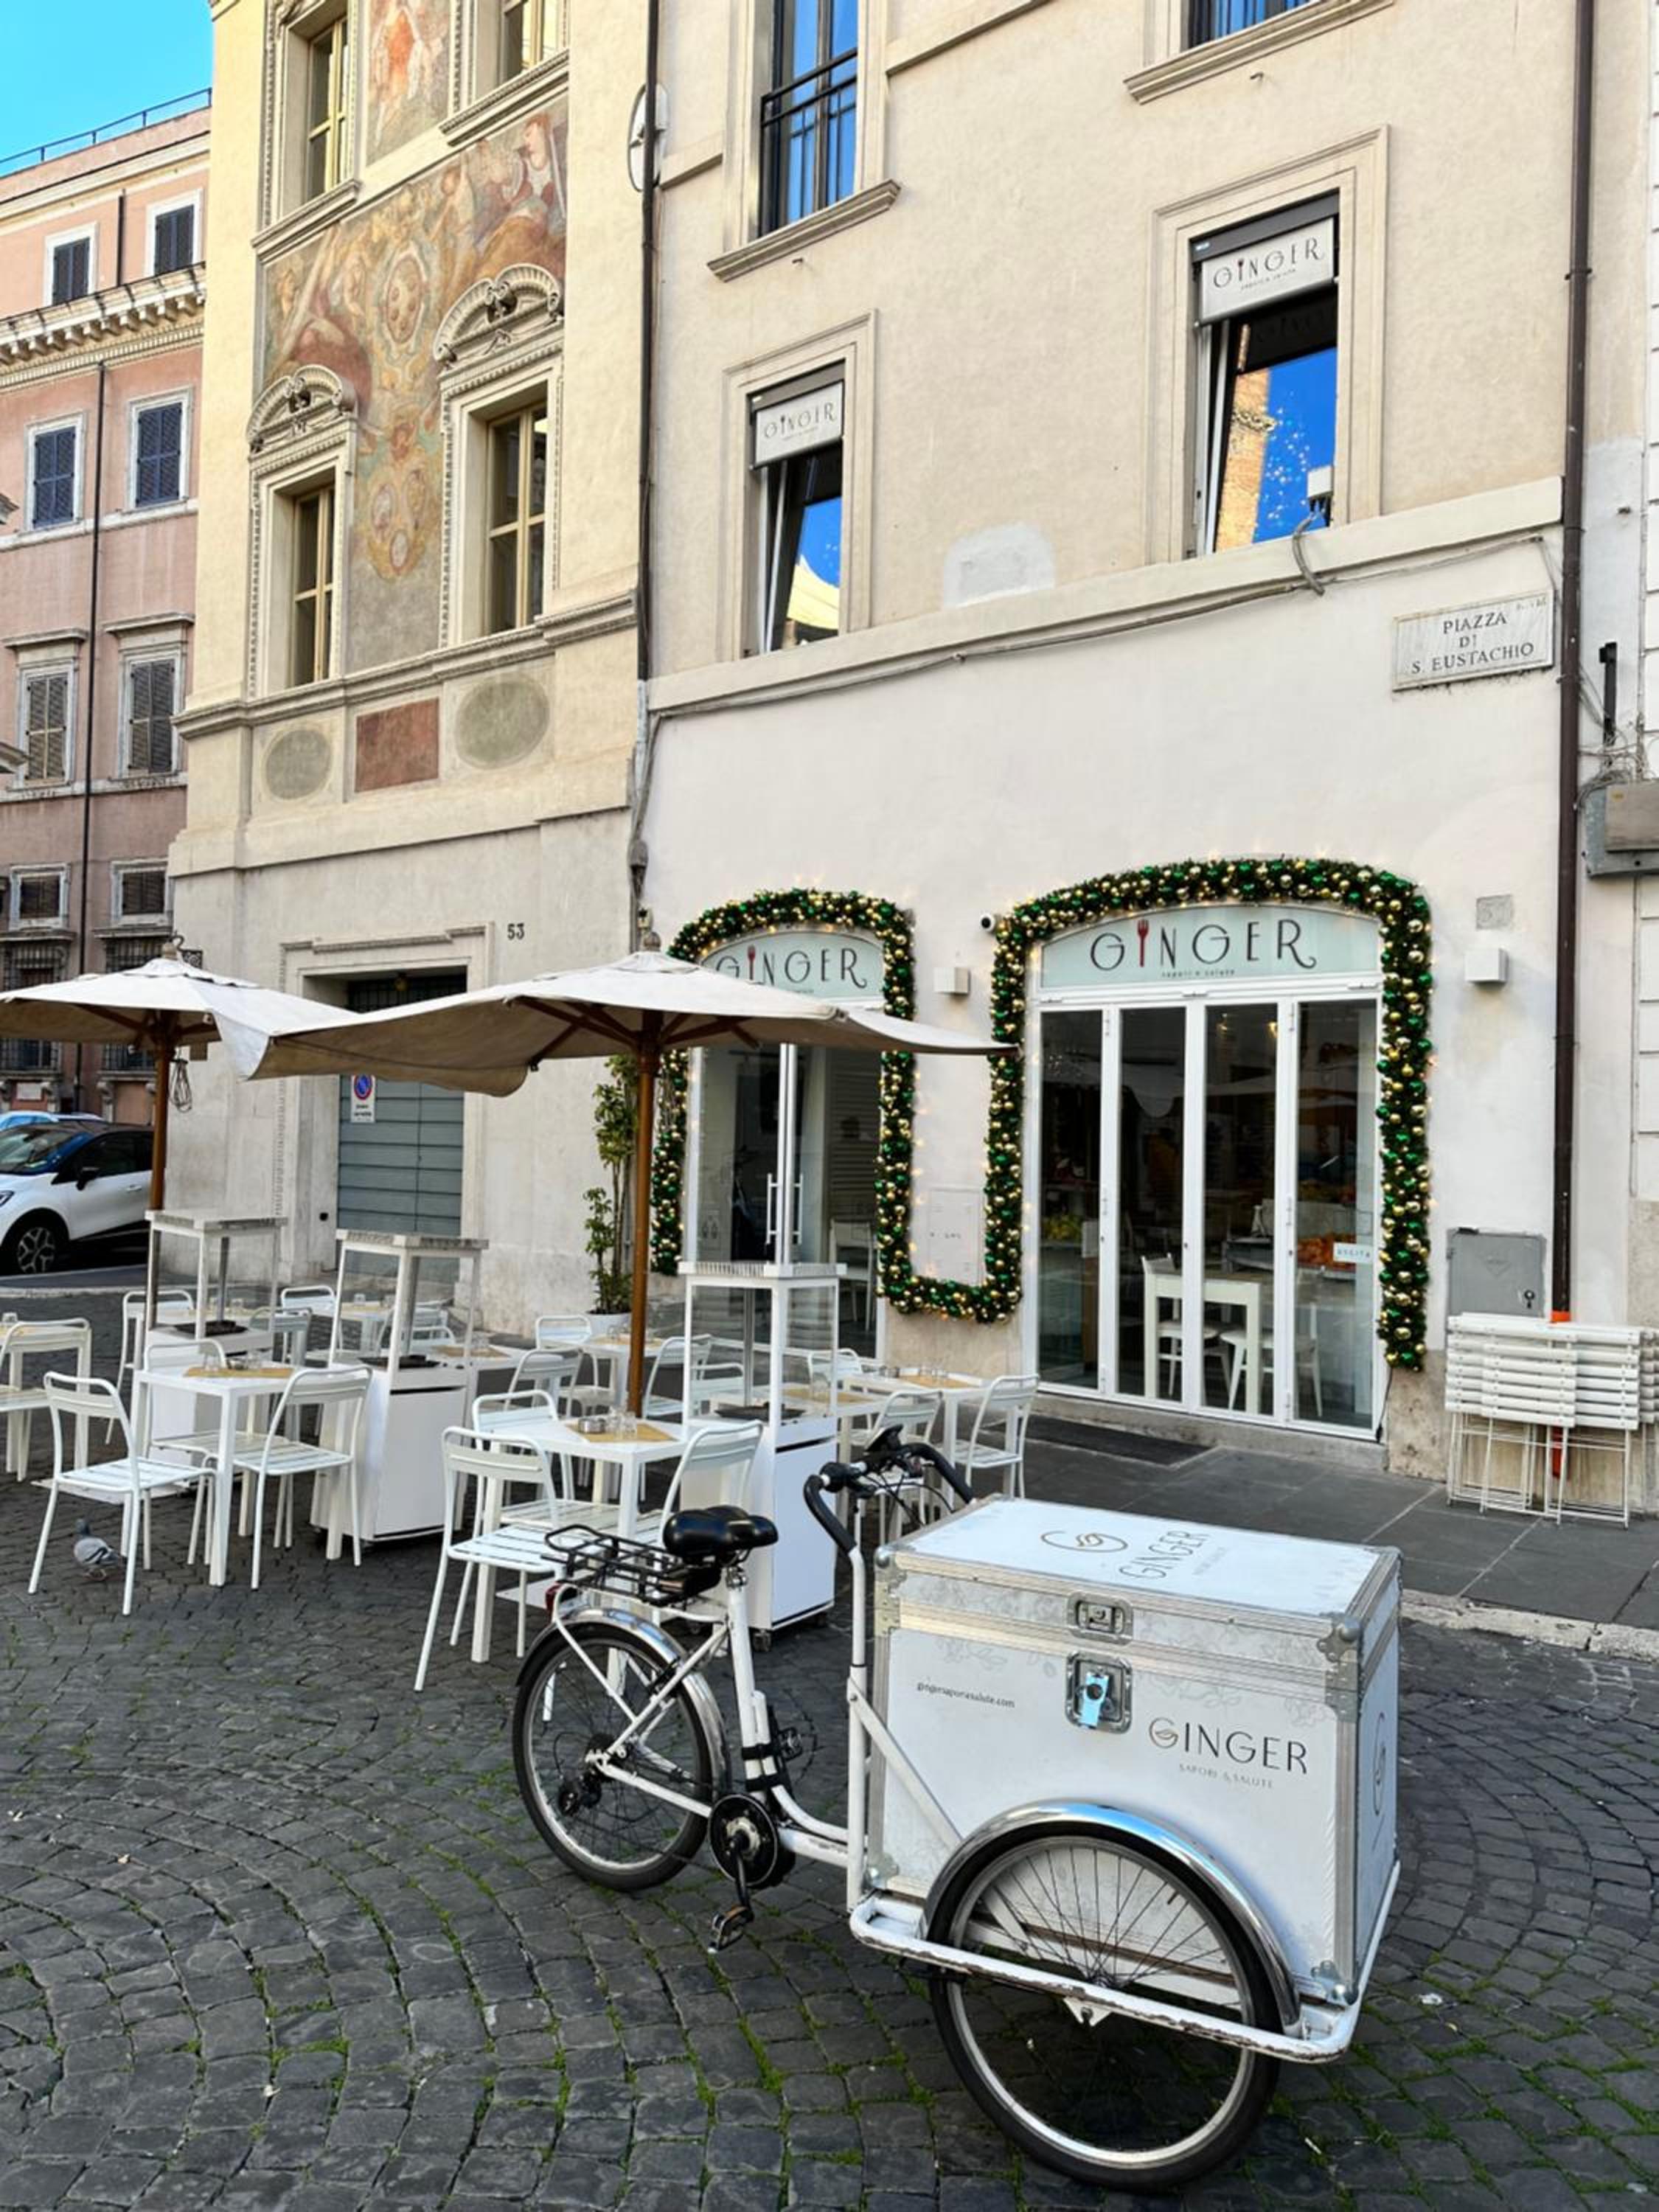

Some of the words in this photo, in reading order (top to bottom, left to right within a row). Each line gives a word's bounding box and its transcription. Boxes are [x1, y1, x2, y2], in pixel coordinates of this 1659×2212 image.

[1443, 611, 1506, 634] PIAZZA
[1459, 634, 1477, 648] DI
[1432, 642, 1534, 672] EUSTACHIO
[507, 922, 524, 941] 53
[1091, 919, 1317, 971] GINGER
[1148, 1717, 1307, 1774] GINGER
